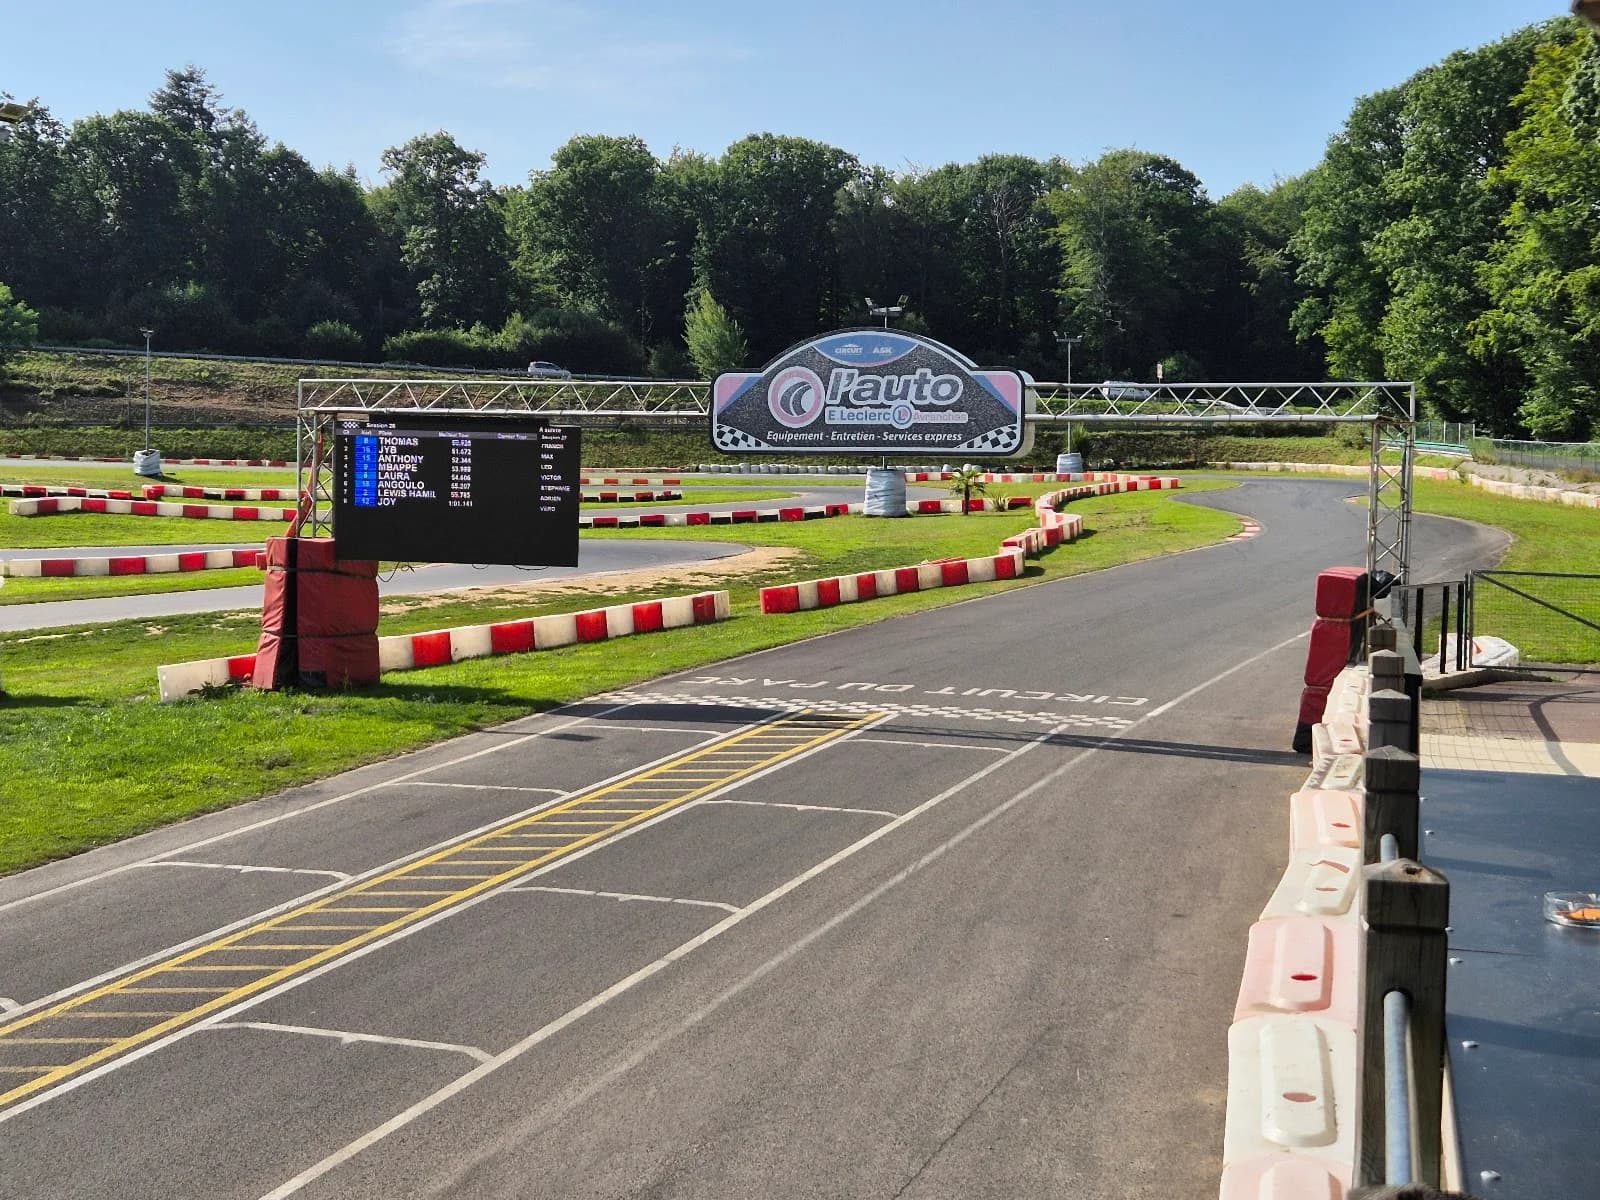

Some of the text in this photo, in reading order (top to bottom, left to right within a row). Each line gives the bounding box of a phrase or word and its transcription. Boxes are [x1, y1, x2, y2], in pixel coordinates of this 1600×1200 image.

[766, 431, 823, 441] Equipement
[831, 431, 875, 440] Entretien
[882, 431, 923, 441] Services
[924, 433, 962, 441] express
[379, 437, 419, 446] THOMAS
[379, 446, 397, 454] JYB
[379, 455, 424, 463] ANTHONY
[378, 472, 410, 480] LAURA
[378, 481, 424, 489] ANGOULO
[378, 489, 406, 497] LEWIS
[378, 498, 397, 506] JOY
[679, 676, 1149, 705] CIRCUIT DU PARC
